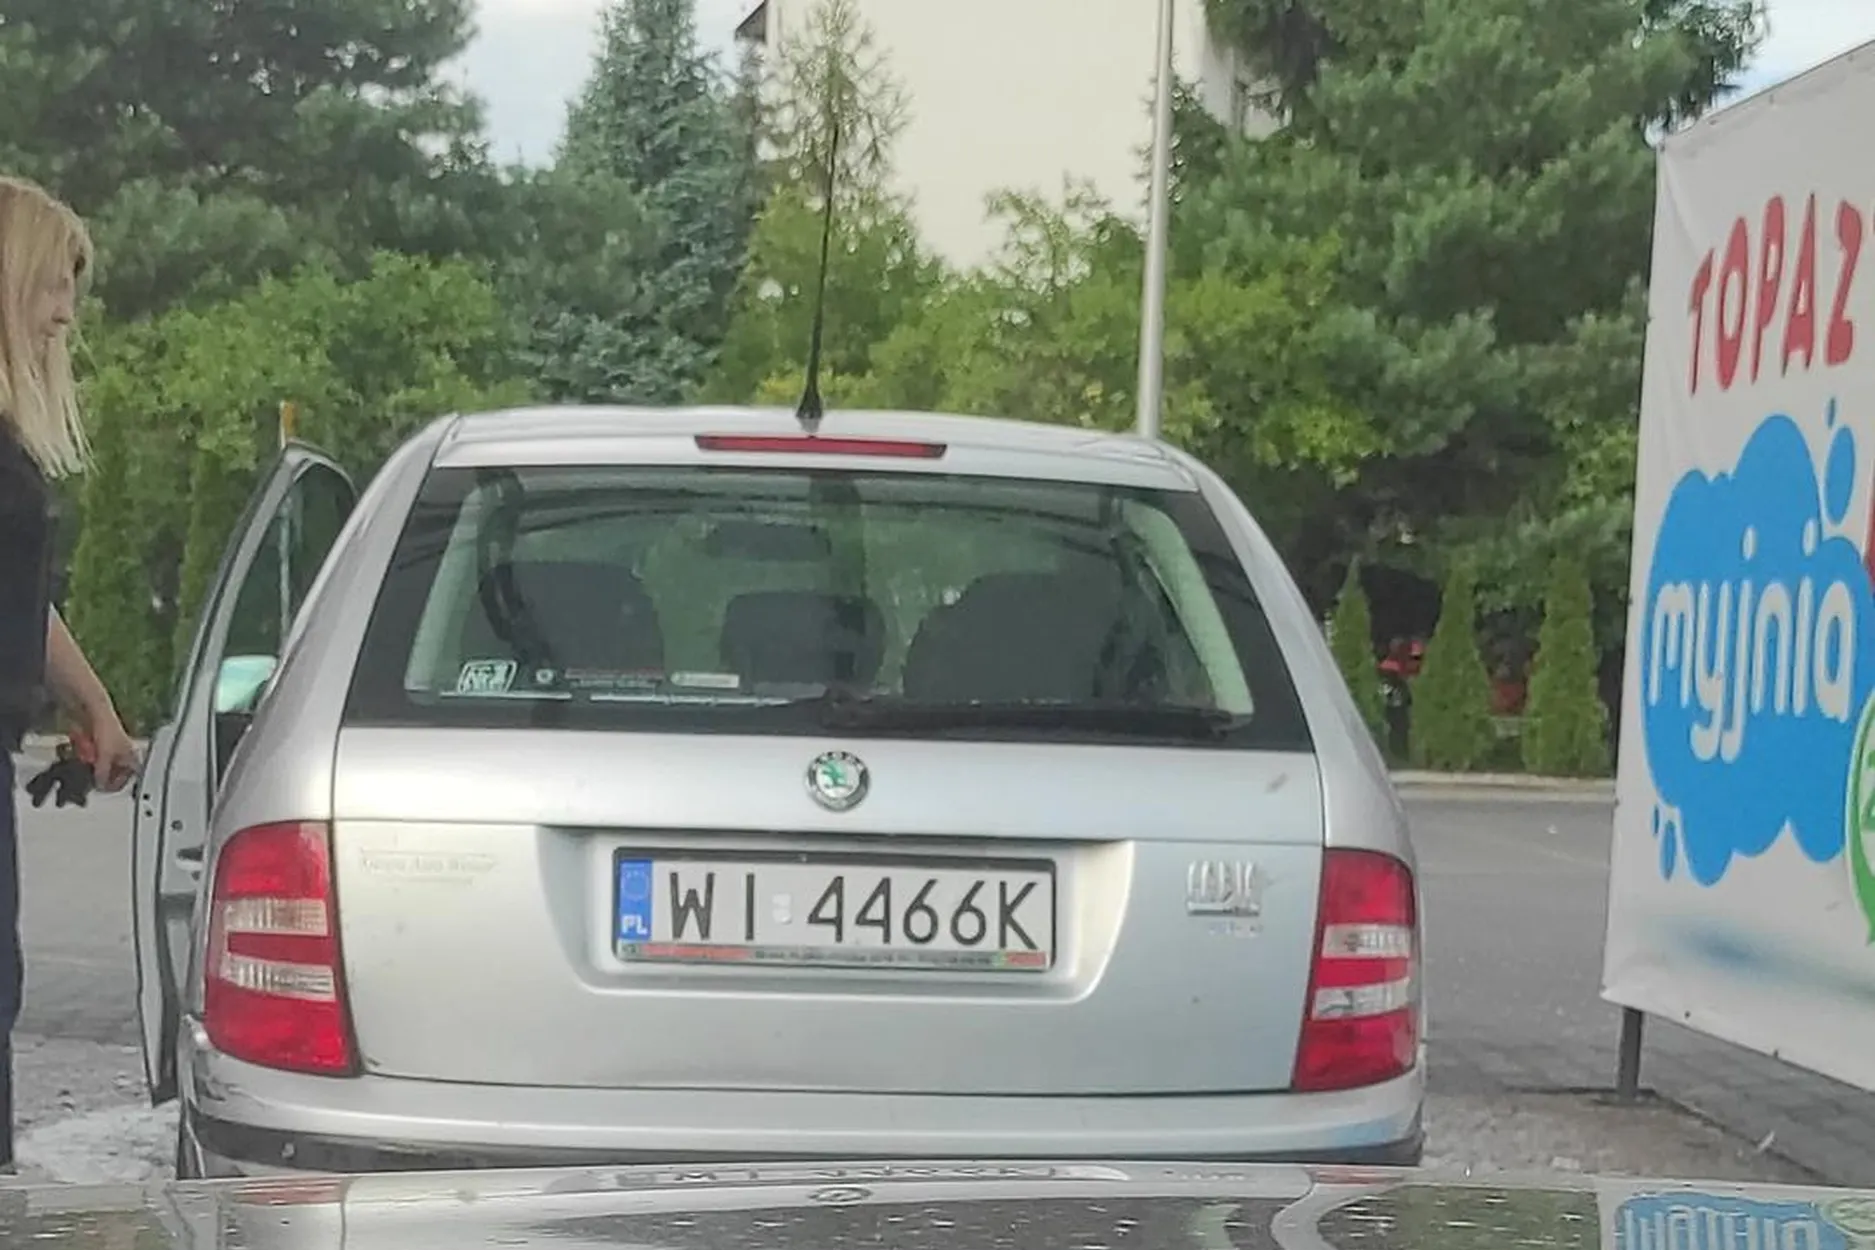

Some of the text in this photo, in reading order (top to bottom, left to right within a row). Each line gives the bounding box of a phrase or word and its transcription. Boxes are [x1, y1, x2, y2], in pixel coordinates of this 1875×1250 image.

[1688, 192, 1875, 397] TOPAZ
[1648, 518, 1855, 764] myjnia
[621, 914, 649, 935] PL
[669, 871, 1039, 950] WI 4466K
